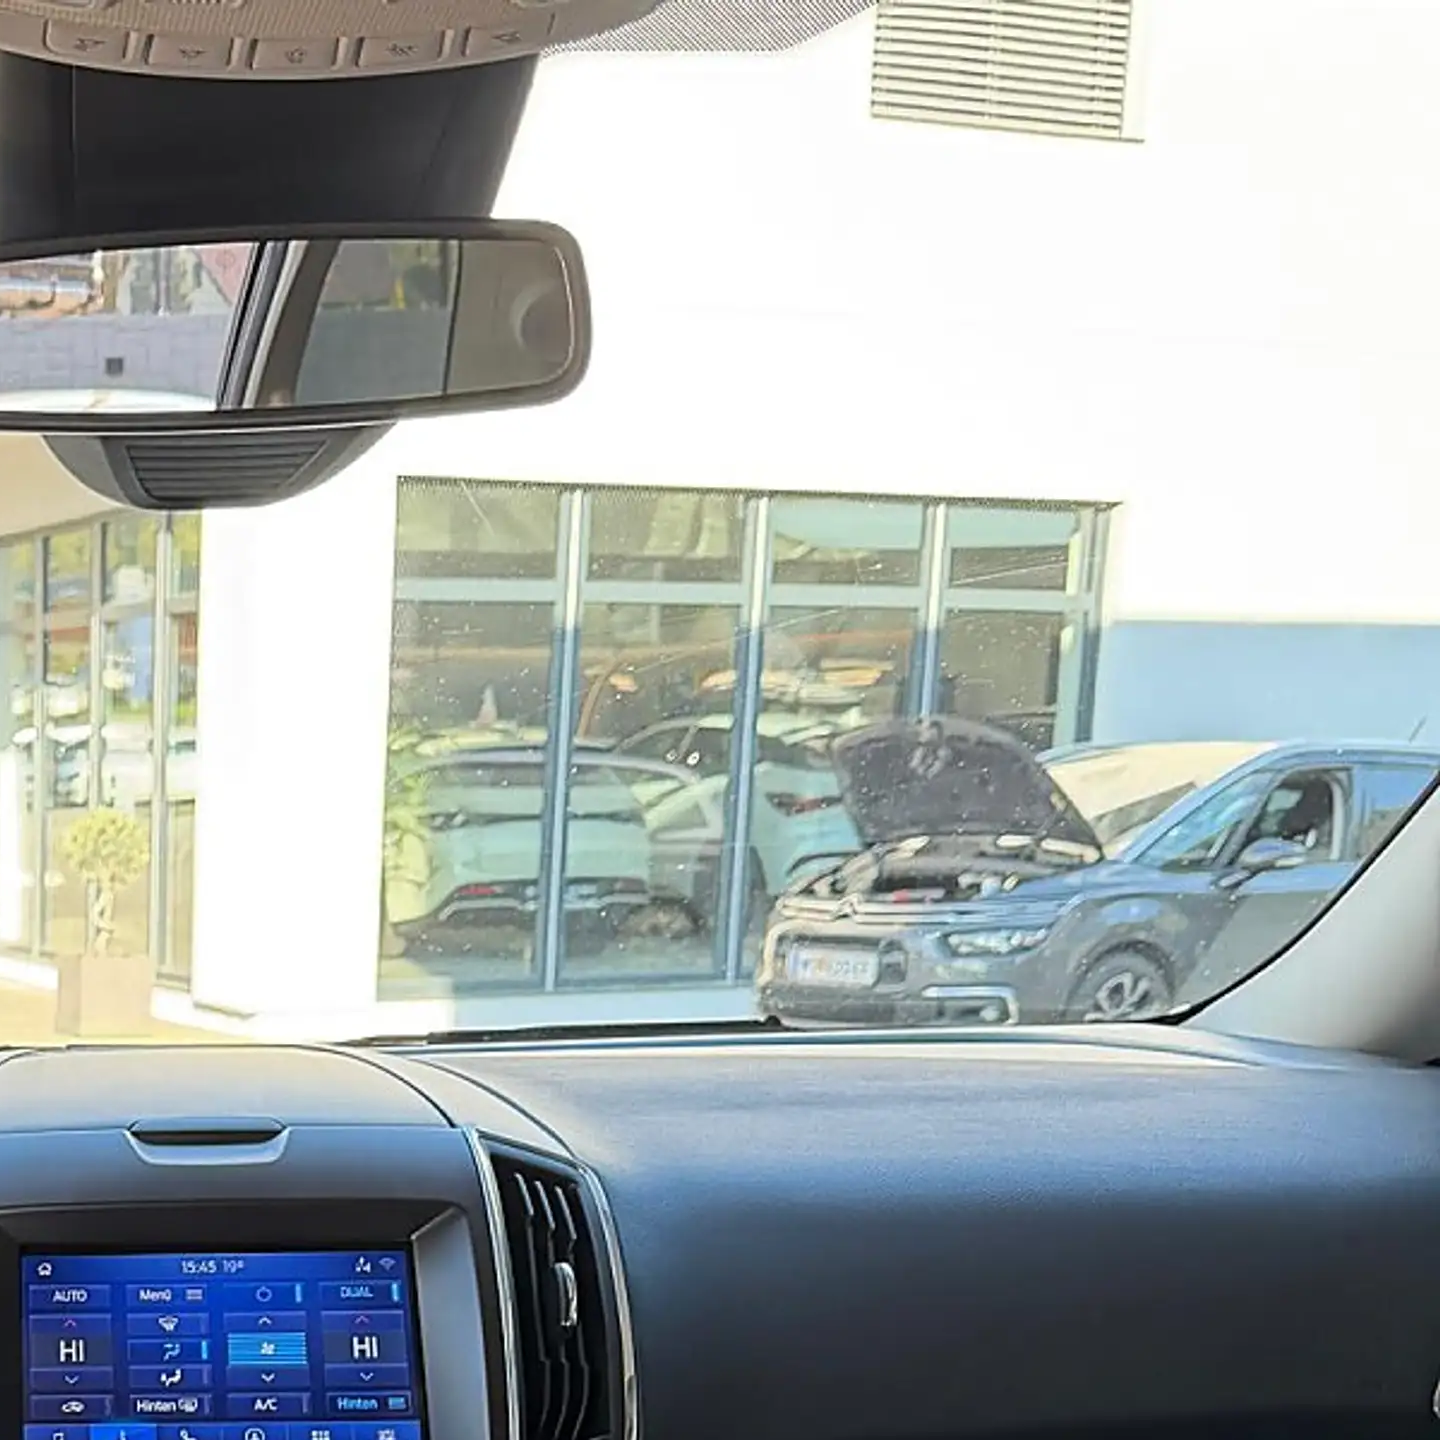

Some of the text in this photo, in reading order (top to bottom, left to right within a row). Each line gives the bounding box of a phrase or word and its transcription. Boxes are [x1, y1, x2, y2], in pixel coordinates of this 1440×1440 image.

[181, 1260, 217, 1274] 15:45
[52, 1290, 88, 1302] AUTO
[340, 1286, 373, 1299] DUAL
[59, 1339, 85, 1363] HI
[352, 1336, 378, 1359] HI
[136, 1400, 177, 1412] Hinten
[254, 1398, 278, 1411] A/C
[337, 1397, 378, 1410] Hinten
